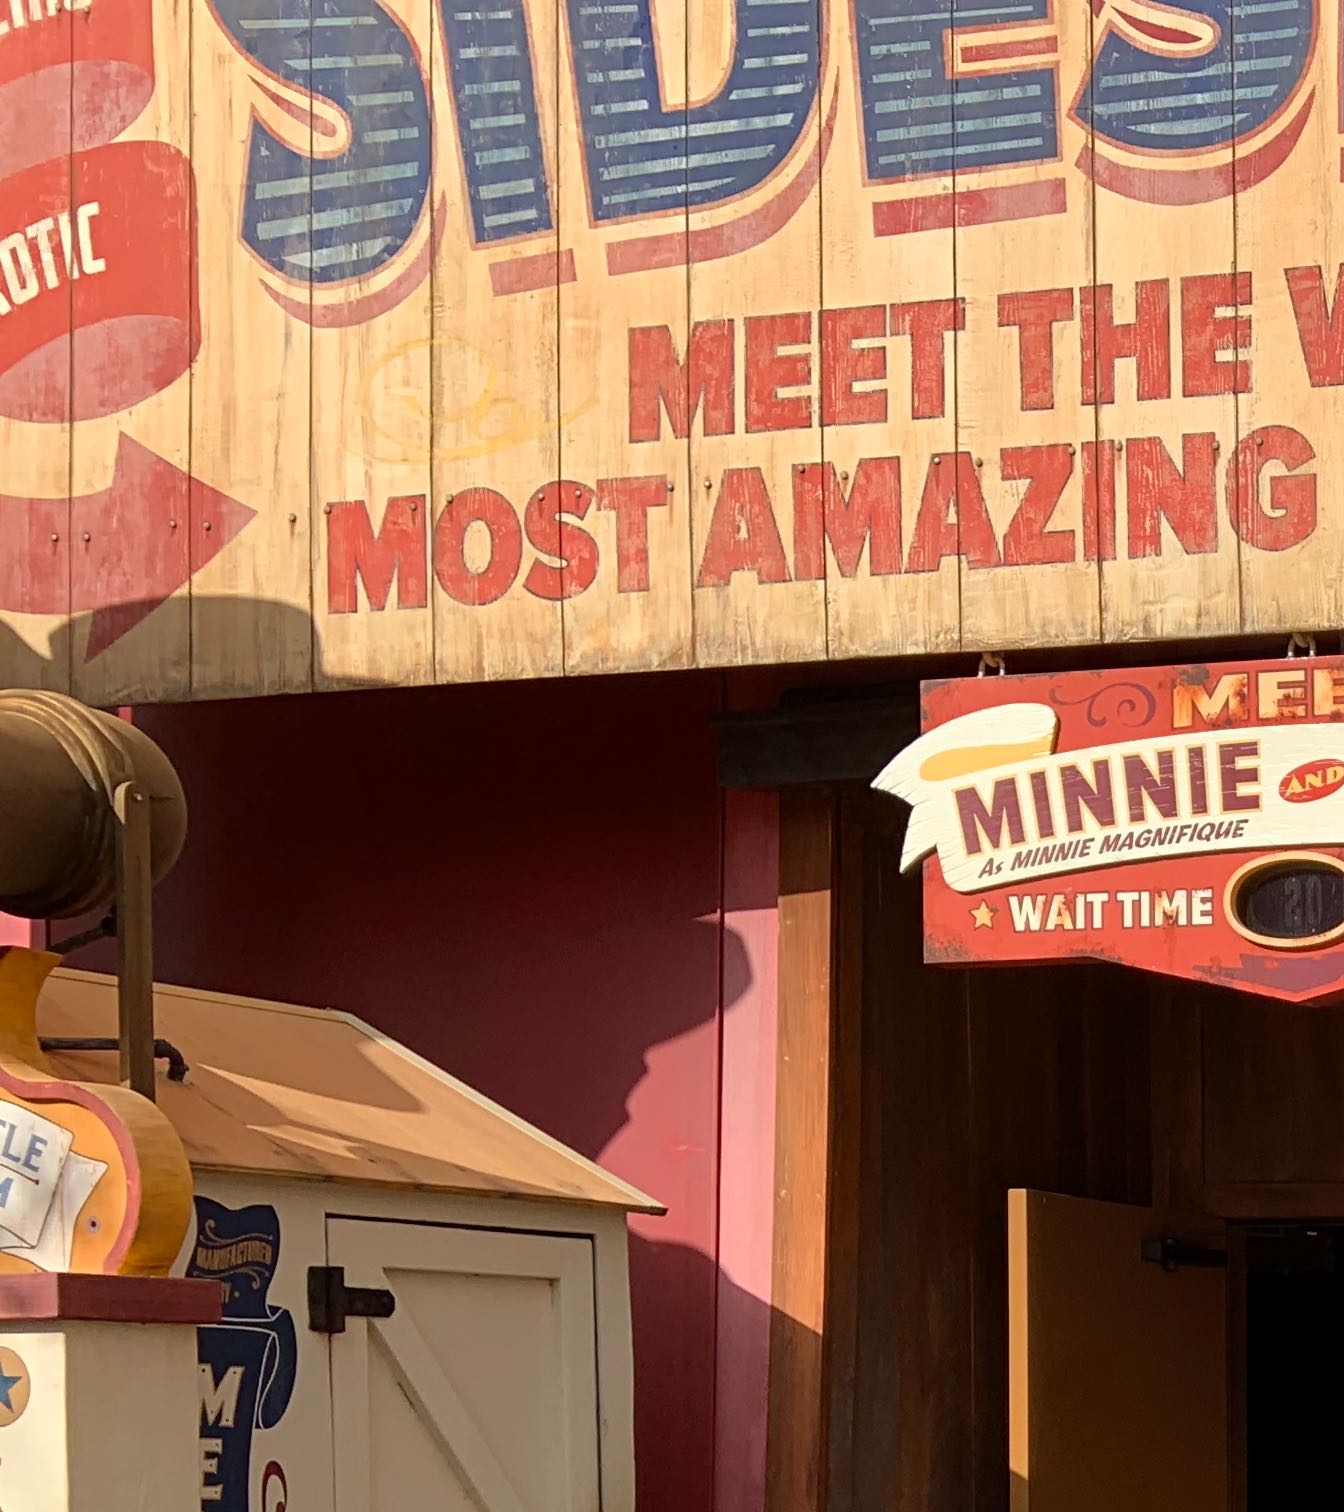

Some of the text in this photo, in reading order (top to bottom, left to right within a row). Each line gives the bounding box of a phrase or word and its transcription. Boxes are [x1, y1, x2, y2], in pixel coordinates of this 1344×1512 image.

[628, 296, 966, 445] MEET
[997, 270, 1252, 417] THE
[325, 474, 668, 615] MOST
[694, 424, 1319, 589] AMAZING
[951, 738, 1264, 856] MINNIE
[978, 818, 1250, 879] As MINNIE MAGNIFIQUE
[1007, 890, 1113, 934] WAIT
[1116, 886, 1215, 929] TIME
